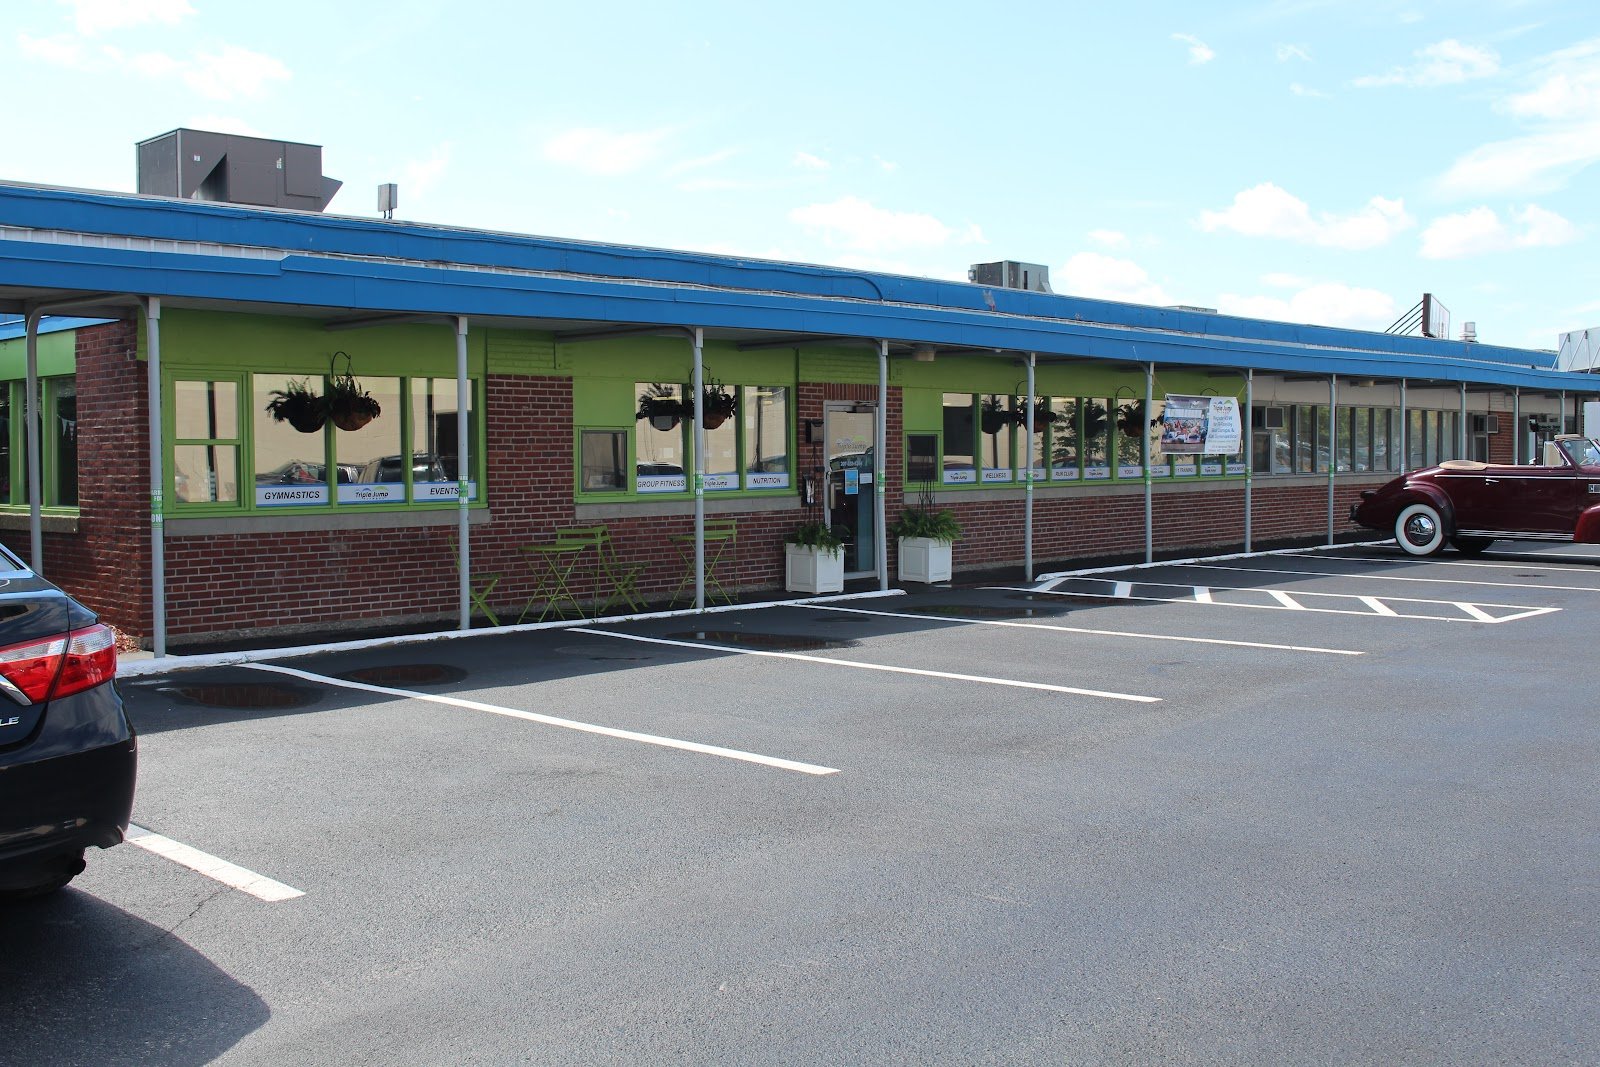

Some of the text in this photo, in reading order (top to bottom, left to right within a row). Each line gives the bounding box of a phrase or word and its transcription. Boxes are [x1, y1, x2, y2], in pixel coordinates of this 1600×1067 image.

[637, 479, 685, 488] GROUP FITNESS
[264, 490, 320, 500] GYMNASTICS
[355, 491, 371, 499] Triple
[430, 487, 460, 496] EVENTS
